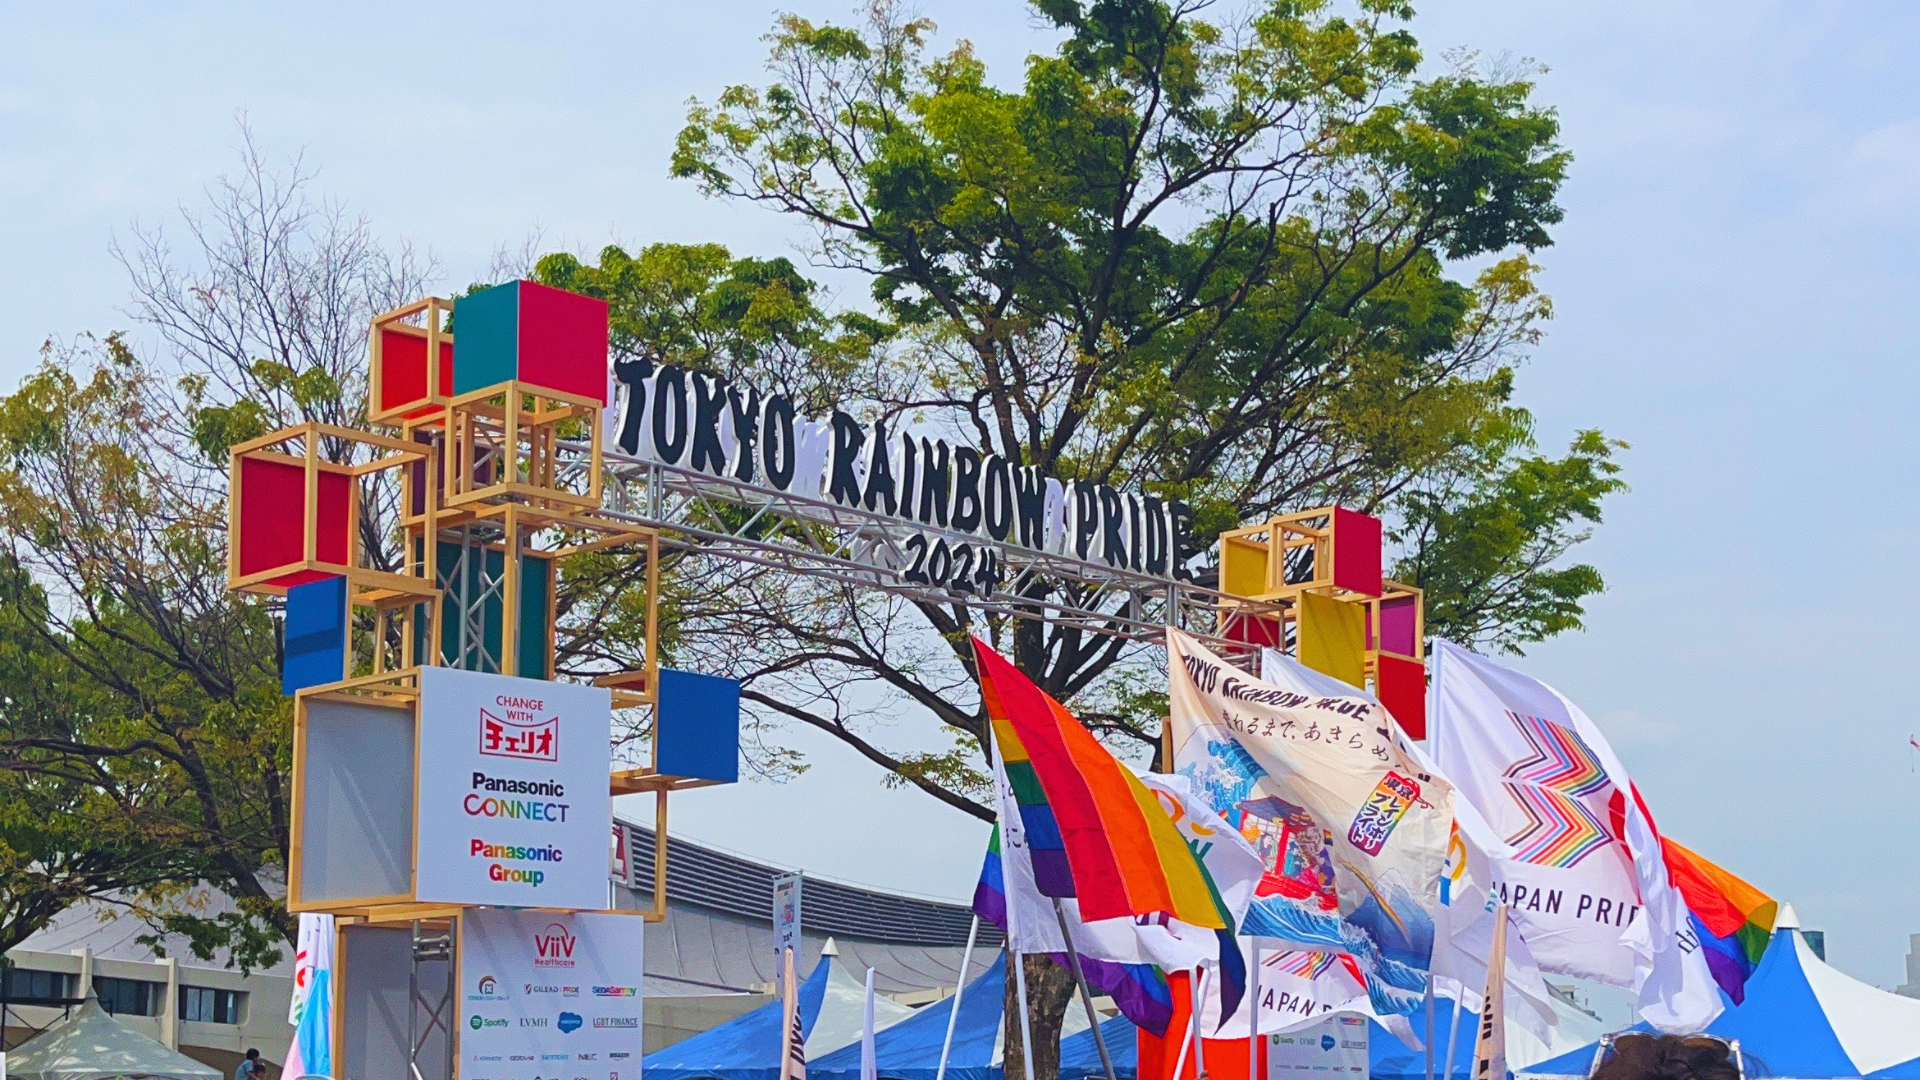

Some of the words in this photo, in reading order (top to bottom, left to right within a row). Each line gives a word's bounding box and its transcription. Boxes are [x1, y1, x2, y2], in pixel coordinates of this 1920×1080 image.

[613, 356, 797, 491] TOKYO
[828, 411, 1048, 551] RAINBOW
[1071, 477, 1194, 585] PRIDE
[902, 533, 1000, 598] 2024
[496, 695, 544, 711] CHANGE
[506, 709, 533, 722] WITH
[485, 718, 552, 756] チェリオ
[472, 771, 564, 797] Panasonic
[463, 793, 570, 822] CONNECT
[470, 838, 562, 862] Panasonic
[489, 863, 544, 887] Group
[535, 934, 576, 958] ViiV
[534, 957, 576, 967] Healthcare
[483, 1018, 510, 1028] Spotify
[520, 1017, 548, 1028] LVMH
[610, 1017, 638, 1027] FINANCE
[578, 1053, 598, 1061] NEC
